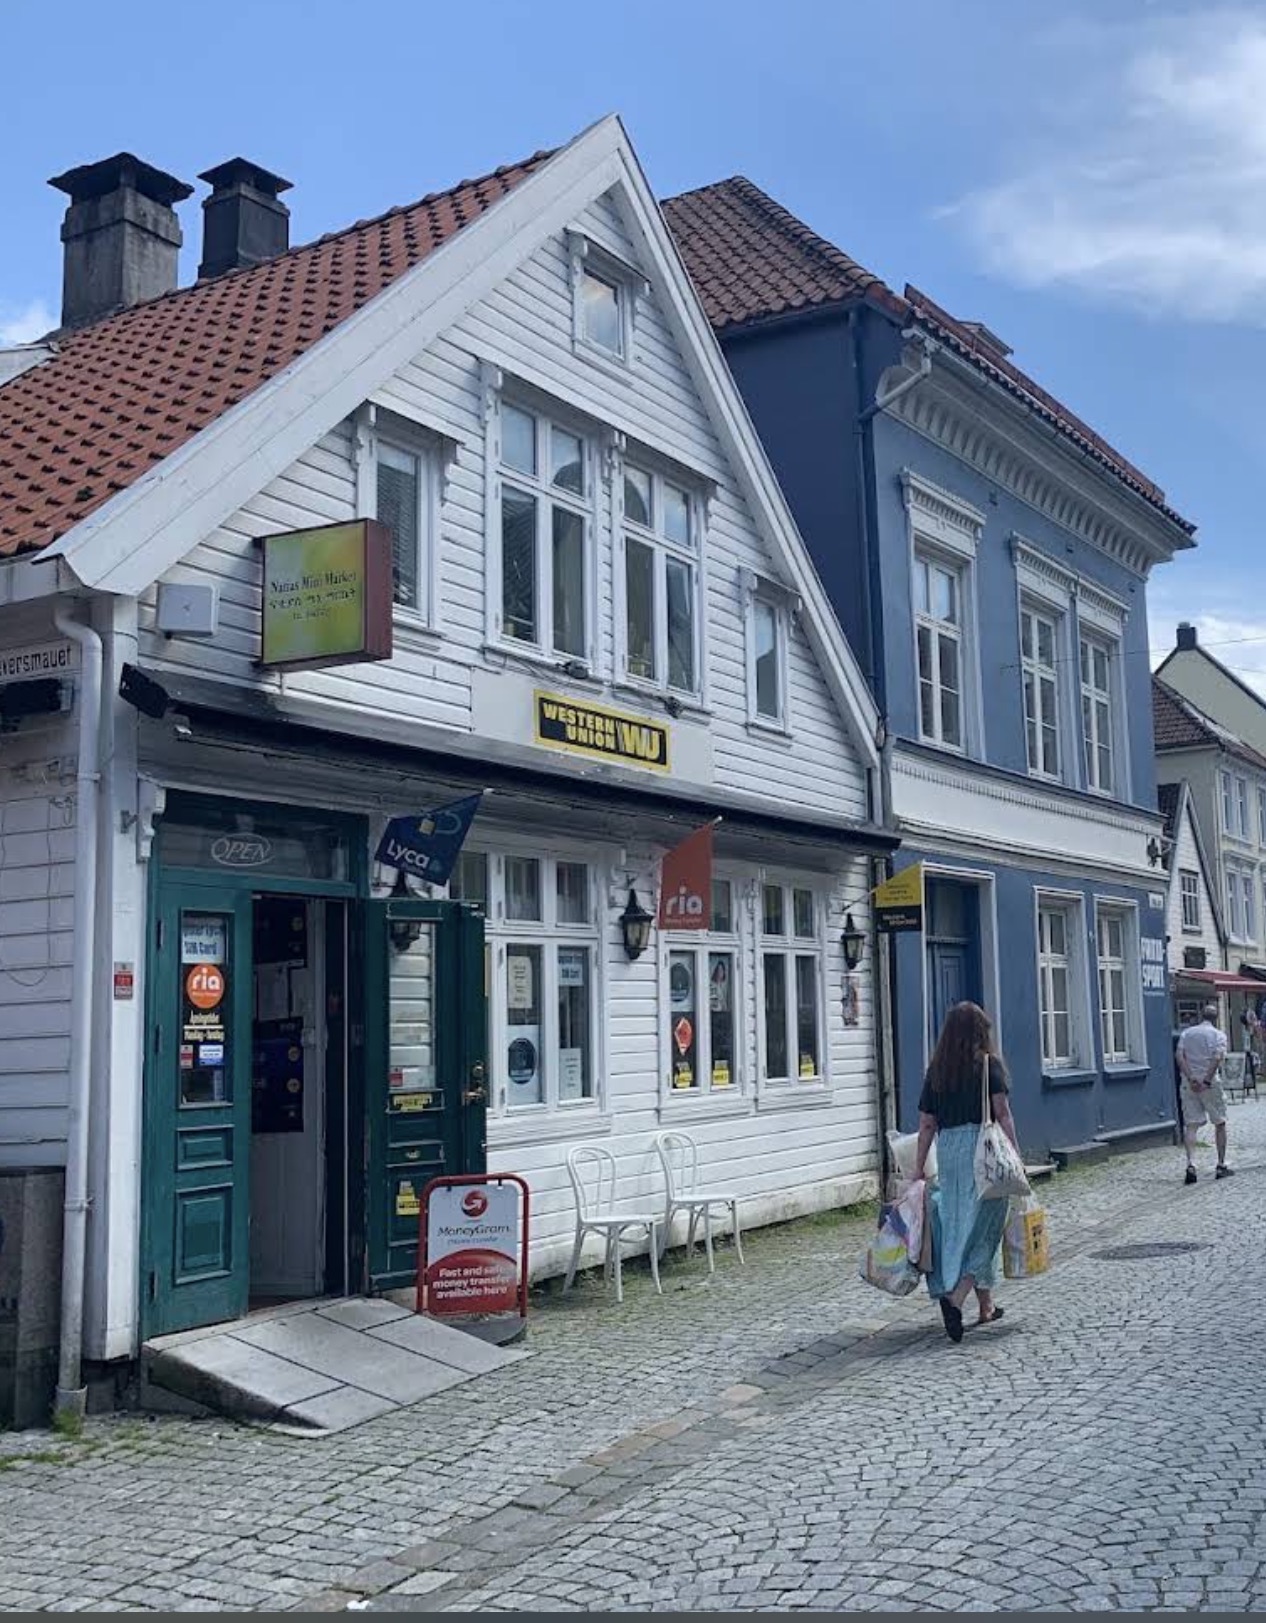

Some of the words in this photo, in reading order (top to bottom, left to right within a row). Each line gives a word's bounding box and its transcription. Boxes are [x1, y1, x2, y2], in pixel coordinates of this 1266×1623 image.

[543, 702, 615, 734] WESTERN
[566, 724, 615, 751] UNION
[211, 838, 269, 861] OPEN
[387, 838, 430, 868] Lyca
[666, 885, 703, 915] ria
[192, 967, 220, 991] ria
[438, 1223, 511, 1238] MoneyGram
[432, 1278, 468, 1289] money
[439, 1267, 462, 1278] Fast
[463, 1266, 482, 1277] and
[436, 1287, 482, 1299] available
[484, 1285, 508, 1295] here
